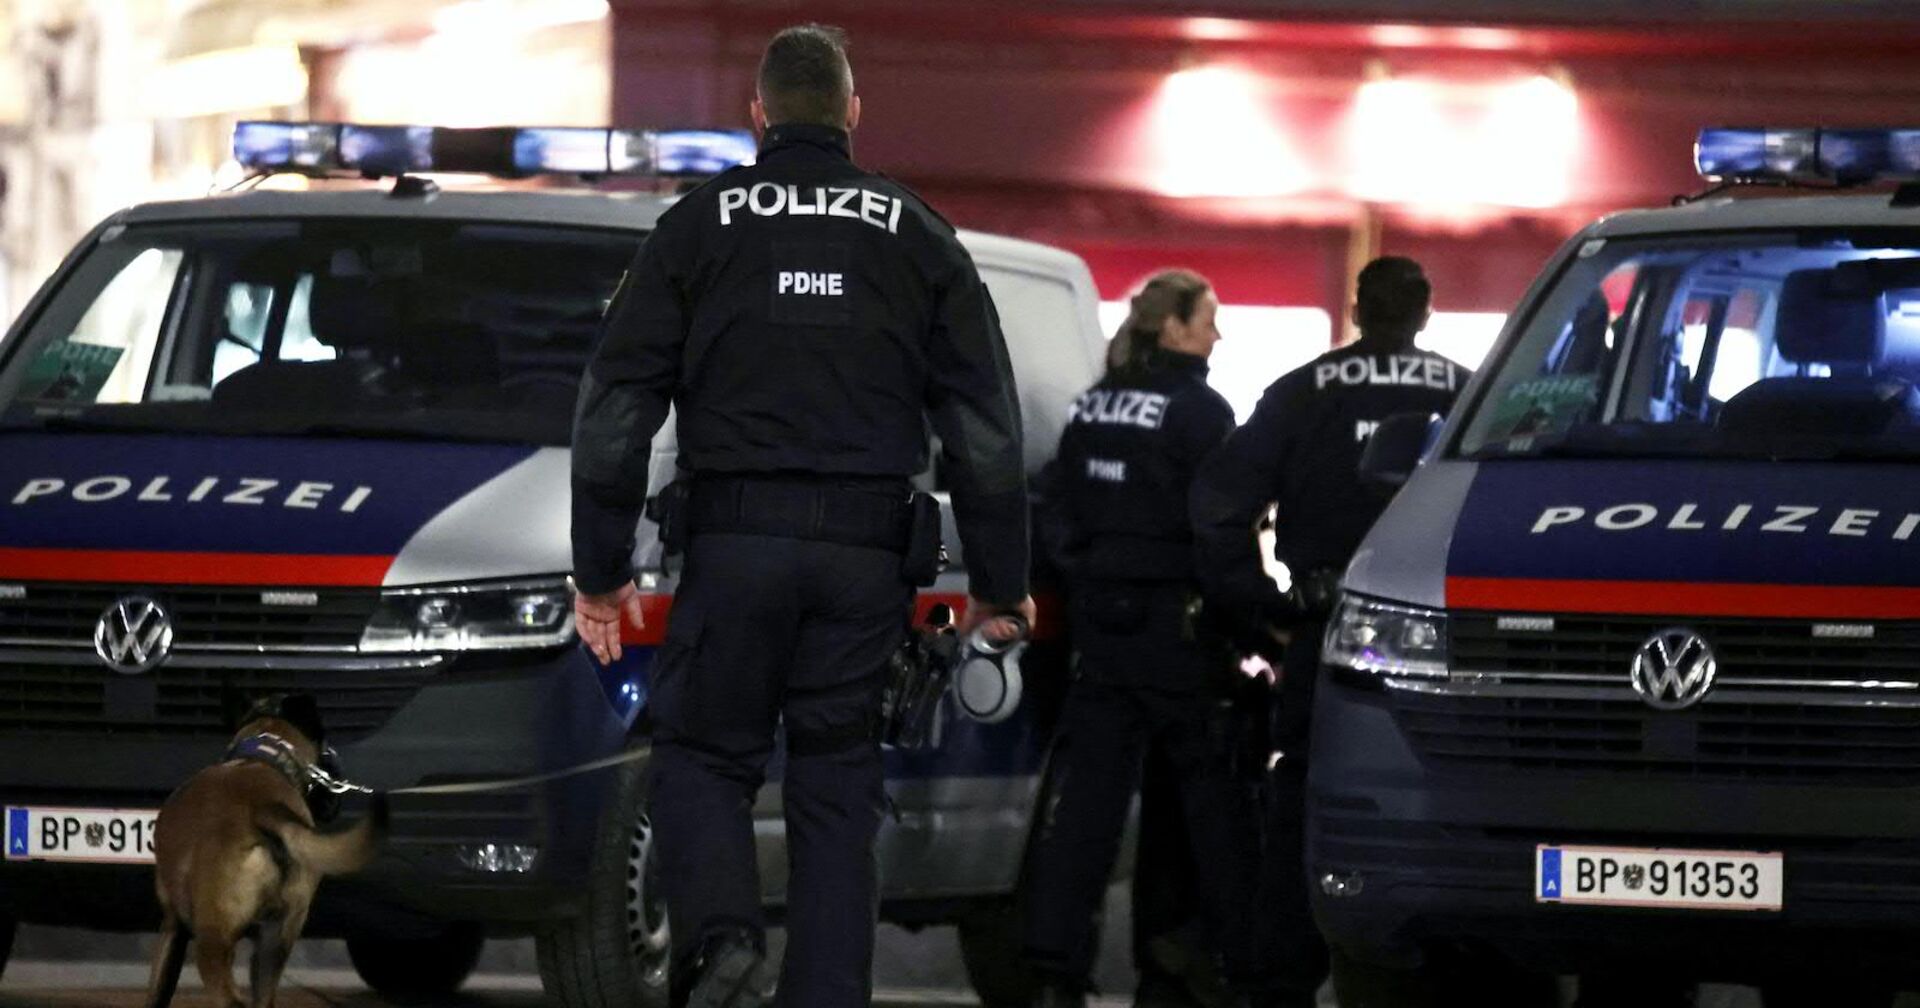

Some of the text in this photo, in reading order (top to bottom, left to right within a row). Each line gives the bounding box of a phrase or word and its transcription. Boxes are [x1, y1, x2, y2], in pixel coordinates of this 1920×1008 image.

[719, 182, 902, 234] POLIZEI
[778, 271, 843, 296] PDHE
[1315, 355, 1457, 391] POLIZEI
[12, 476, 372, 513] POLIZEI
[1530, 504, 1920, 540] POLIZEI
[41, 817, 81, 851] BP
[1576, 858, 1760, 899] BP 91353
